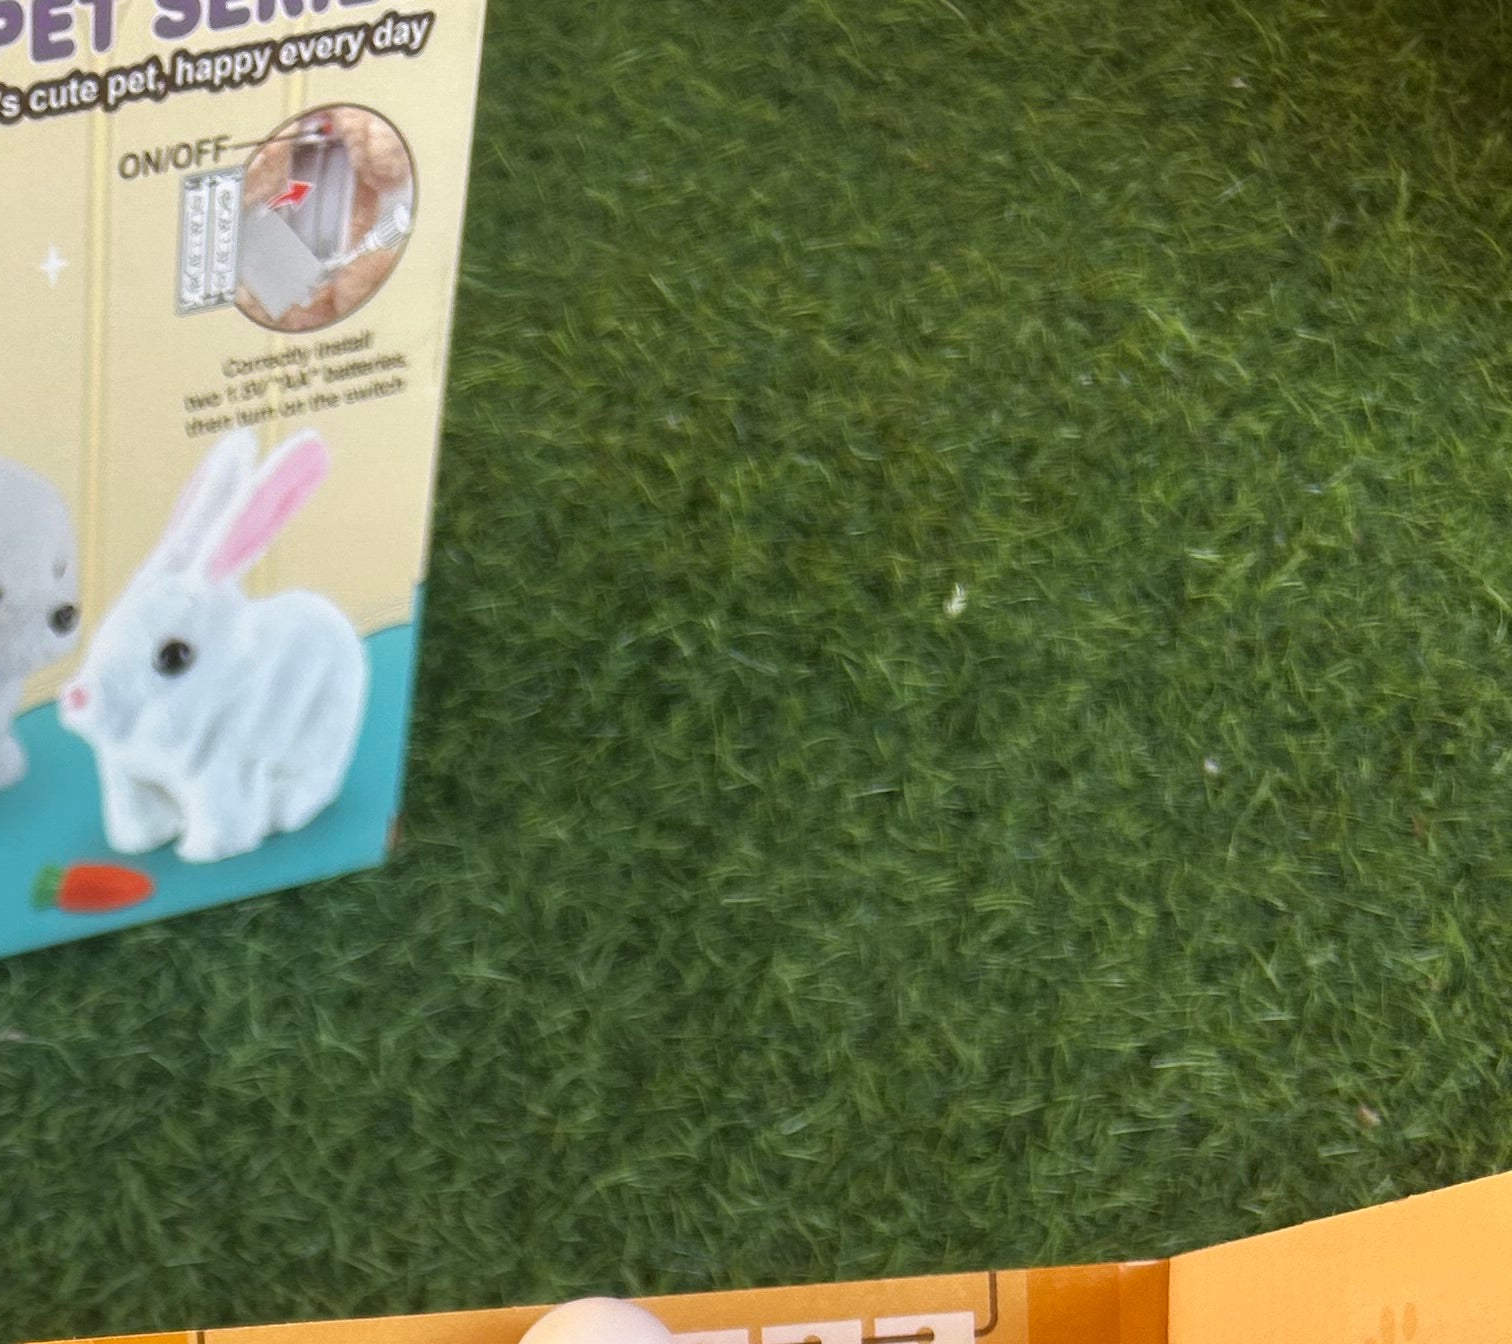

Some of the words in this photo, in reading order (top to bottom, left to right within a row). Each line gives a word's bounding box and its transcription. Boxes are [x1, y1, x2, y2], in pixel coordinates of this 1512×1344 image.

[29, 79, 100, 112] cute
[107, 65, 166, 104] pet,
[175, 44, 272, 86] happy
[279, 28, 367, 65] every
[373, 16, 429, 49] day
[118, 134, 232, 180] ON/OFF
